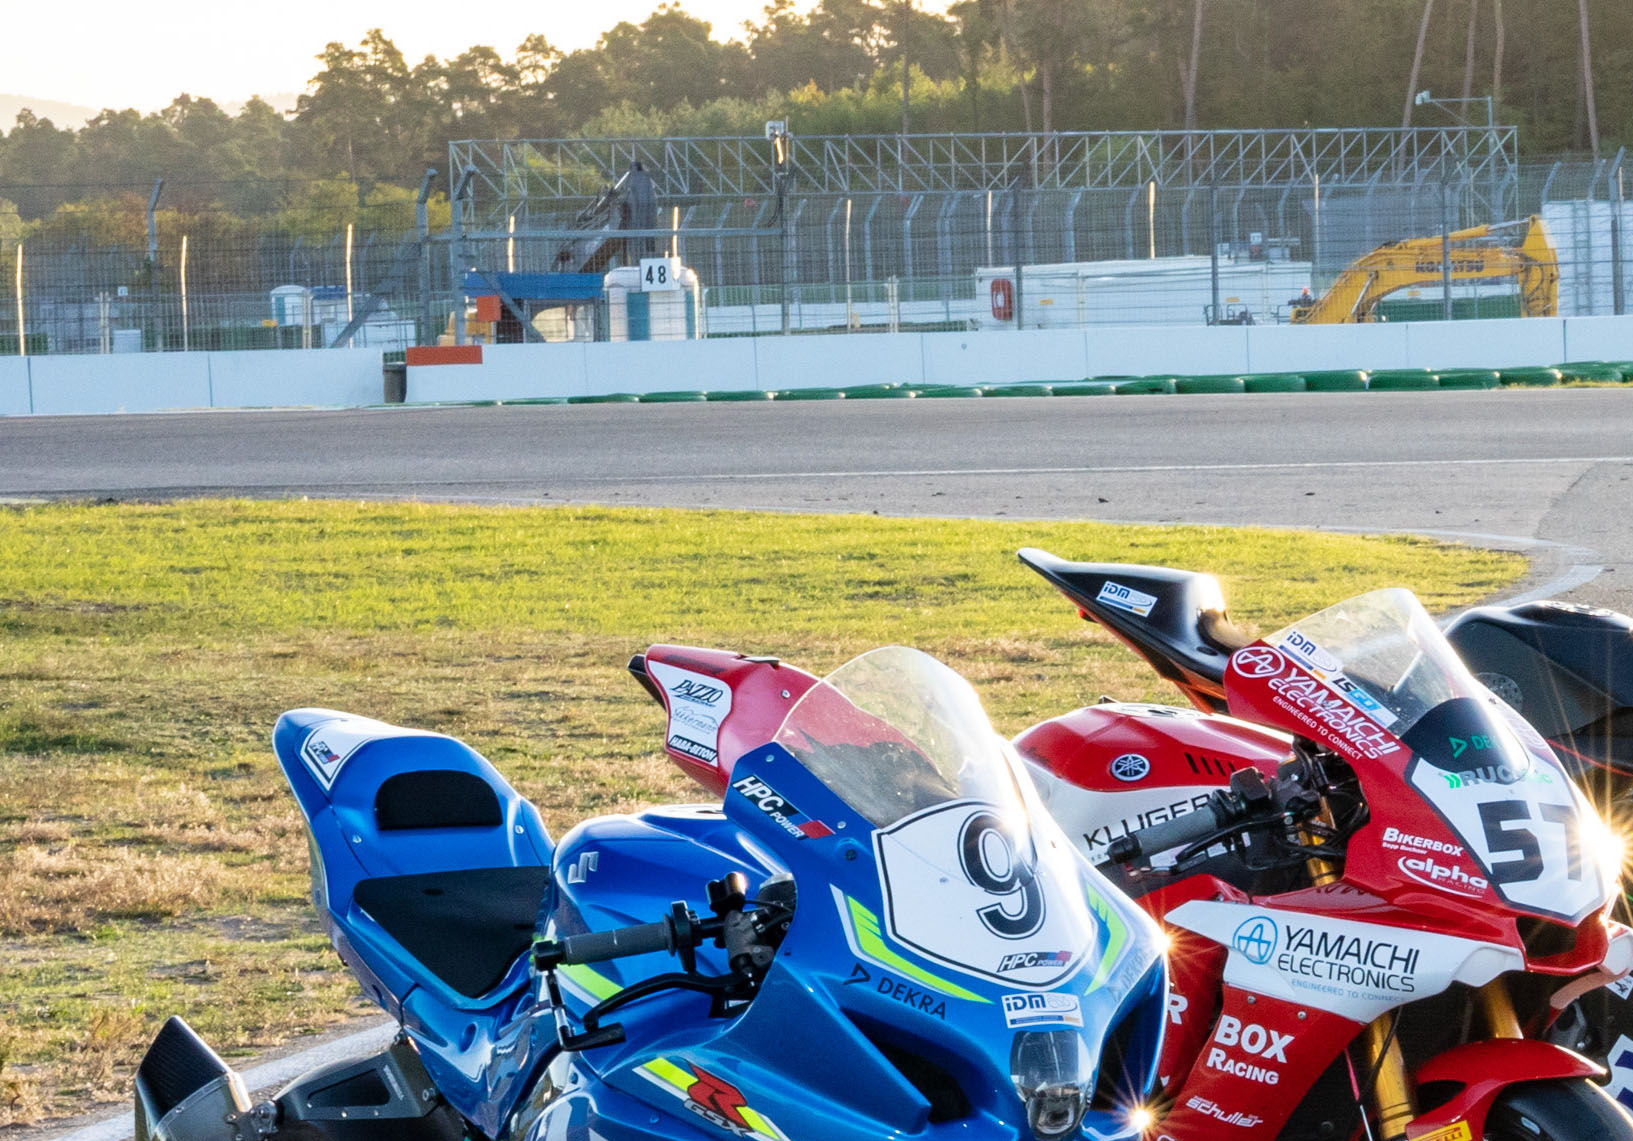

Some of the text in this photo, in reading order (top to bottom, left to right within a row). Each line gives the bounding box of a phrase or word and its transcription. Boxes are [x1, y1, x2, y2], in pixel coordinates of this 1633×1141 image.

[645, 265, 668, 285] 48
[671, 679, 724, 704] PAZZO
[1279, 666, 1401, 756] YAMAICHI
[1267, 679, 1383, 760] ELECTRONICS
[1272, 695, 1364, 761] ENGINEERED TO CONNECT
[732, 776, 803, 840] HPC POWER
[1382, 826, 1465, 858] BIKERBOX
[1477, 799, 1583, 885] 57
[957, 810, 1047, 940] 9
[1406, 857, 1489, 887] alpha
[1001, 952, 1039, 970] HPC
[1285, 924, 1421, 975] YAMAICHI
[1277, 953, 1416, 993] ELECTRONICS
[1290, 978, 1360, 999] ENGINEERED TO
[876, 976, 947, 1020] DEKRA
[1213, 1014, 1295, 1064] BOX
[1206, 1047, 1280, 1086] RACING
